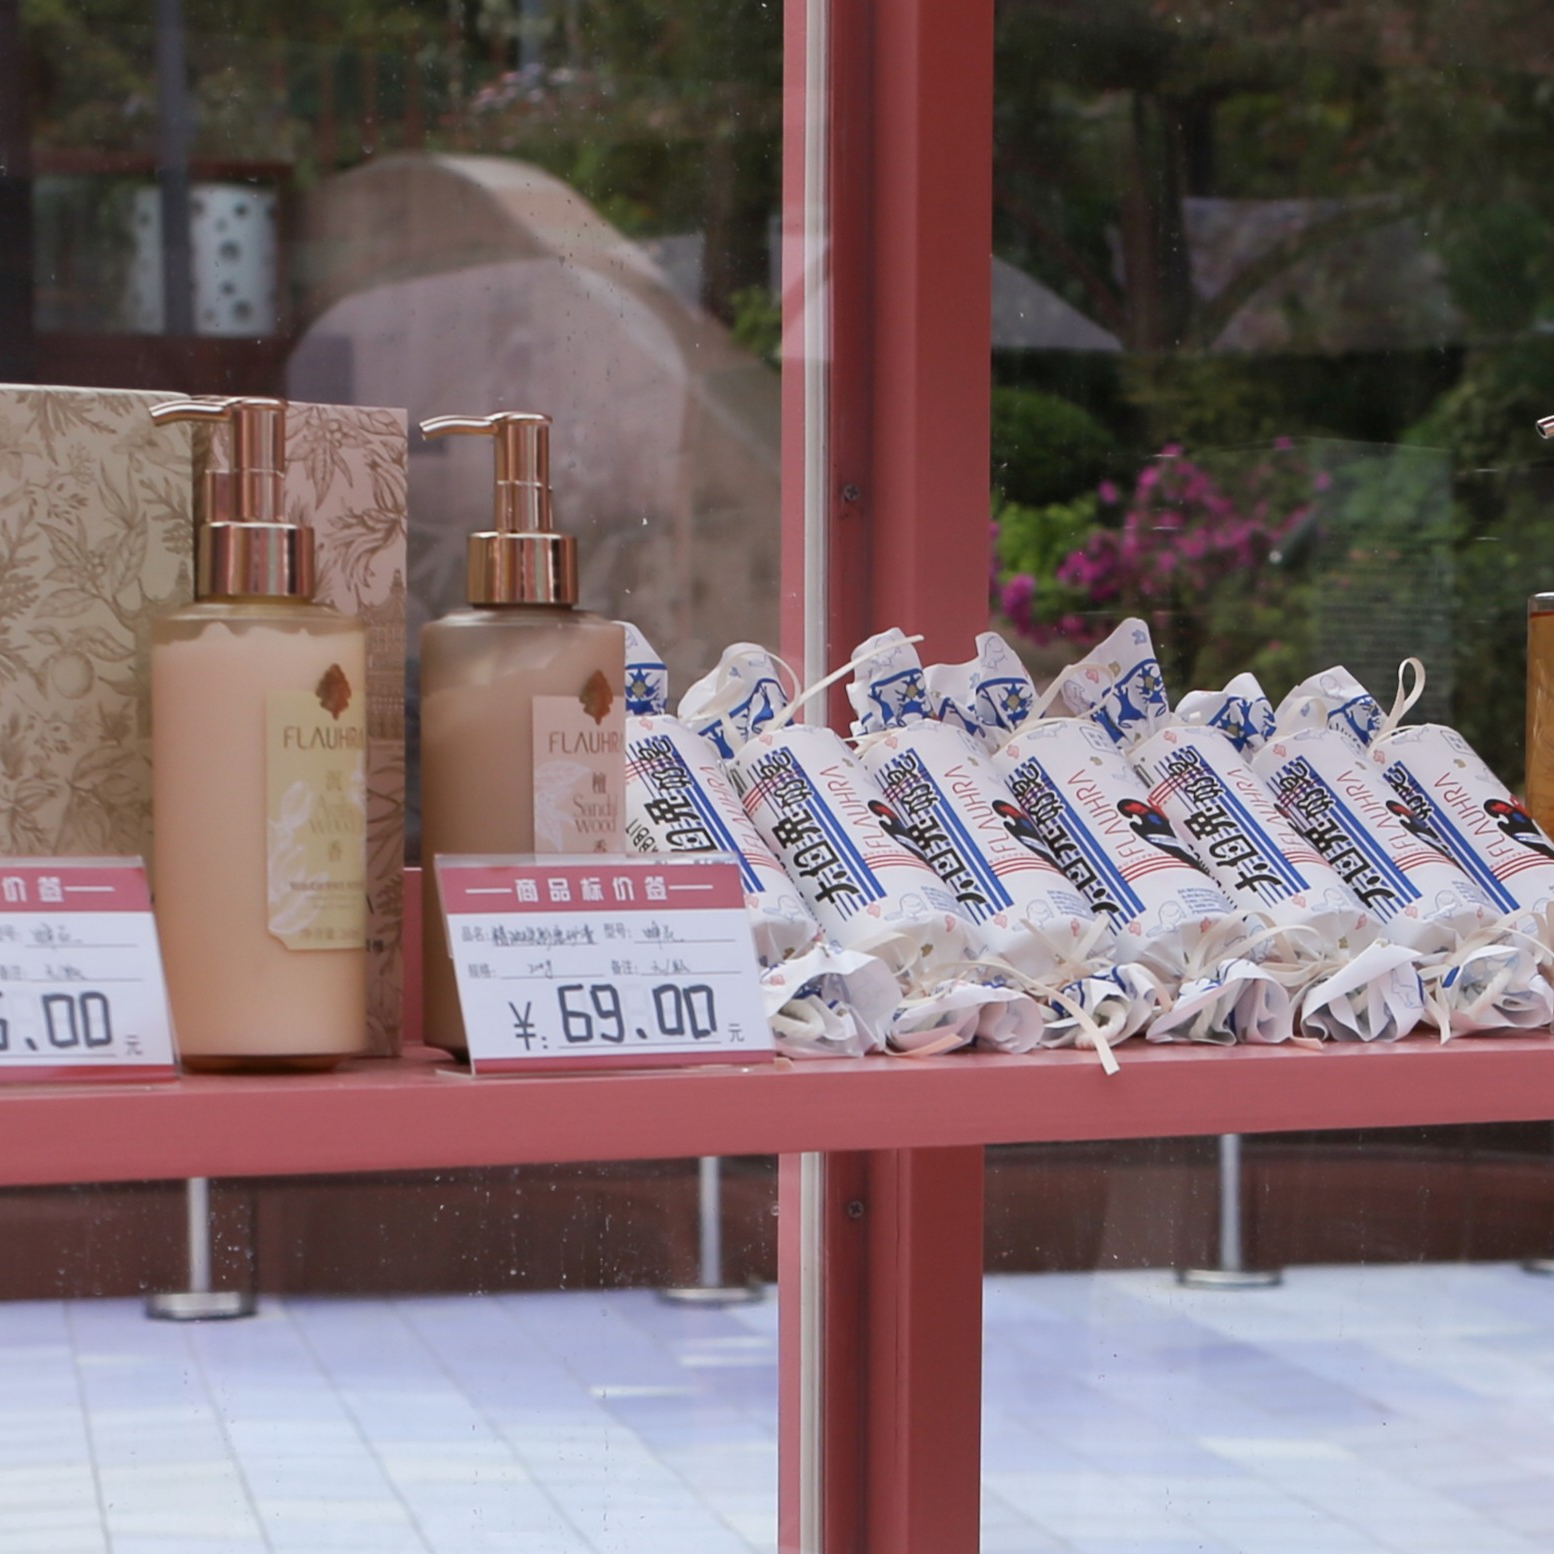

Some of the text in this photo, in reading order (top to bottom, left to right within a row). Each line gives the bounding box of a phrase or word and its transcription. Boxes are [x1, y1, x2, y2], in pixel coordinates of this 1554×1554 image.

[819, 766, 891, 849] FLAUHRA
[944, 765, 1017, 854] FLAUHRA
[1067, 769, 1145, 859] FLAUHRA
[1336, 770, 1416, 850] FLAUHRA
[1434, 772, 1514, 859] FLAUHRA
[514, 876, 668, 902] 商品标价签
[557, 983, 717, 1043] 69.00
[728, 1023, 745, 1043] 元
